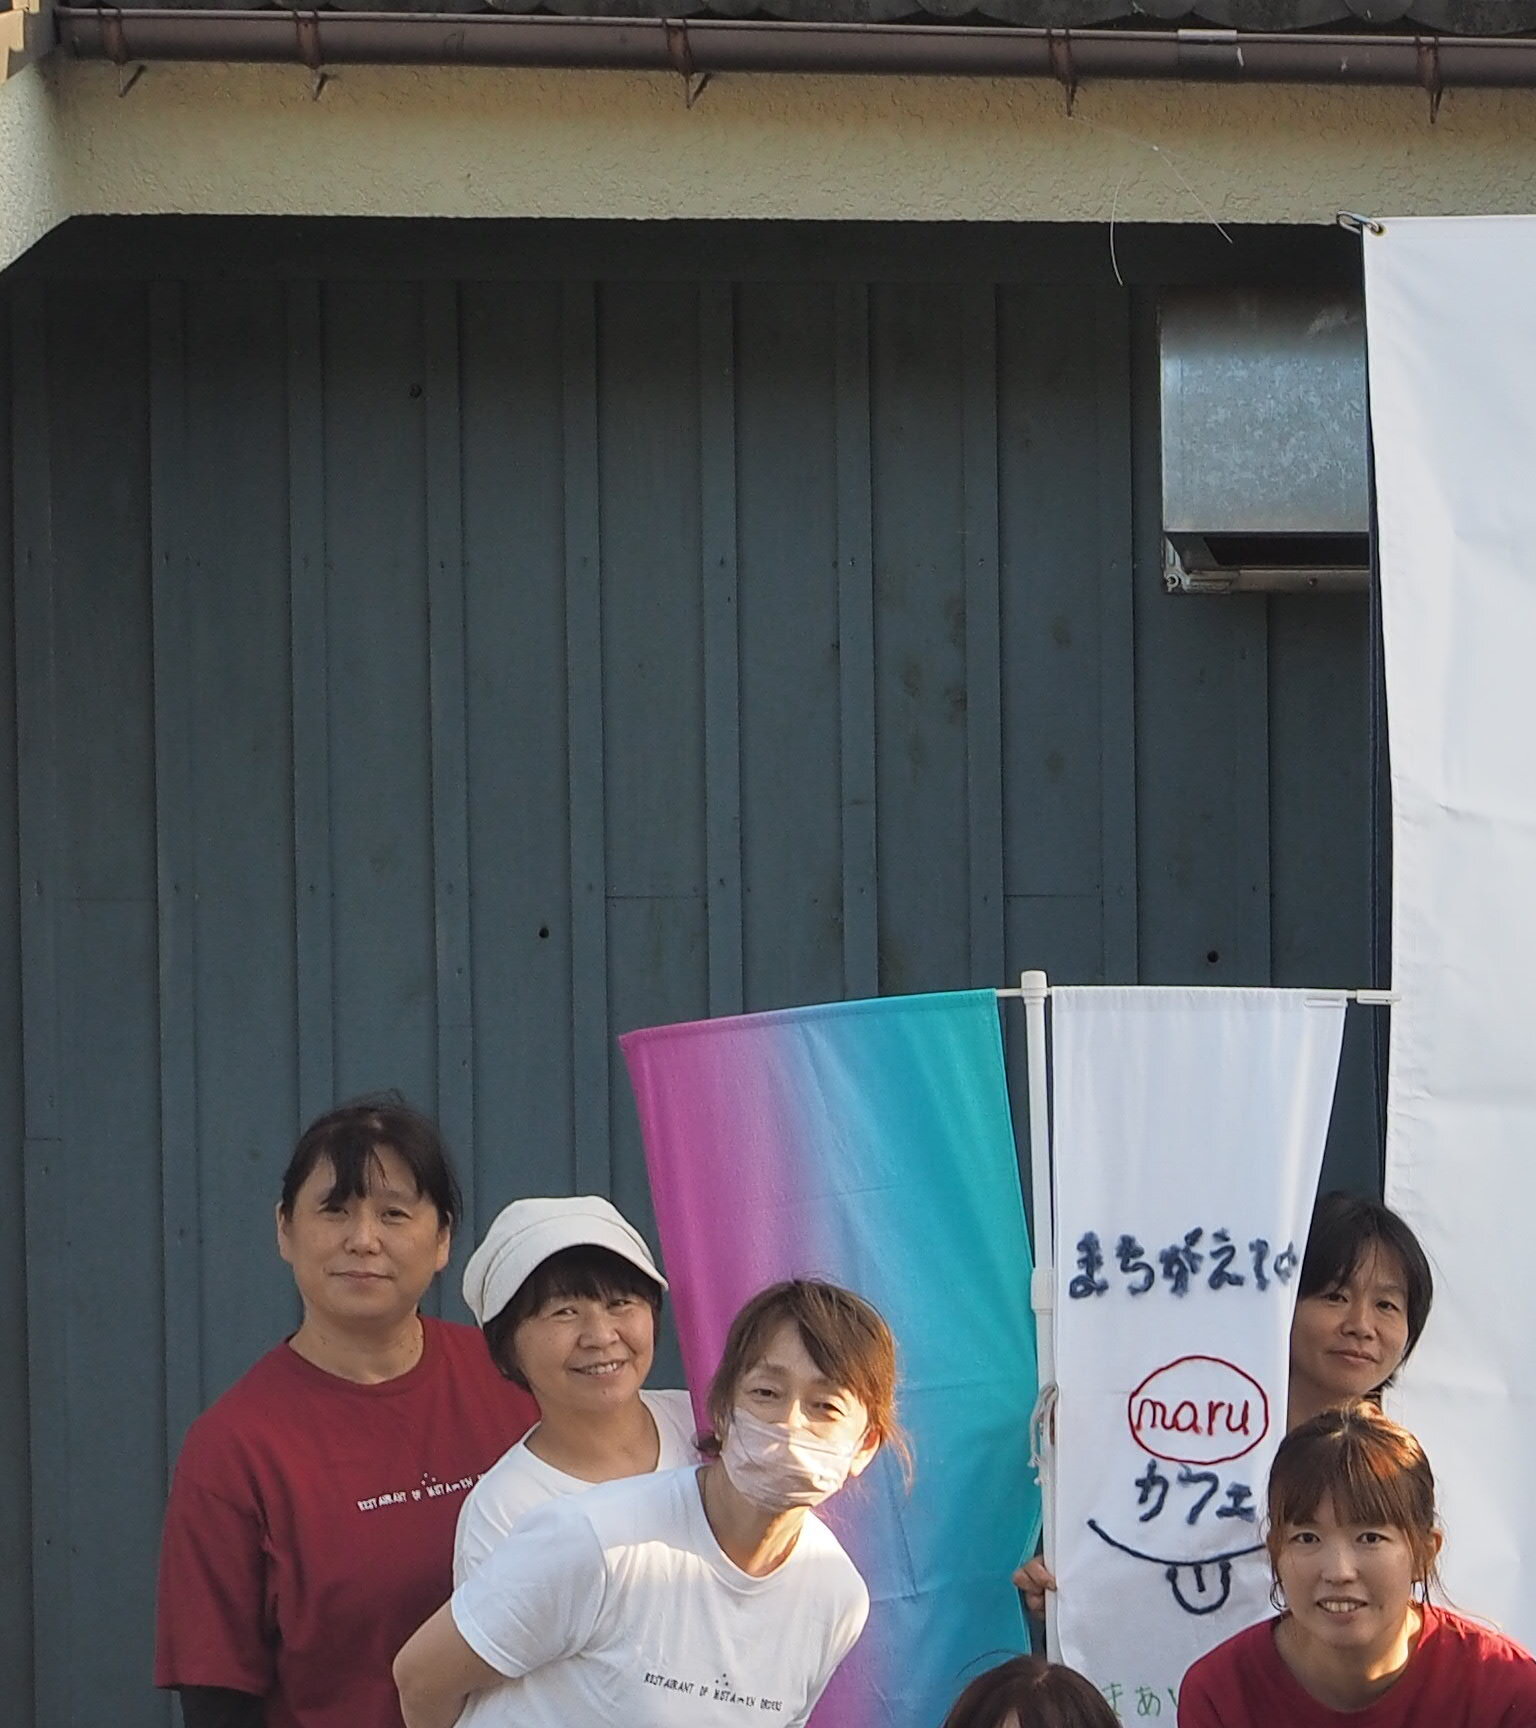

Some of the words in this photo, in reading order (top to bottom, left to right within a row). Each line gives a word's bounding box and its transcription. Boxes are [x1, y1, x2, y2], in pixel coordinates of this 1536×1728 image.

[1135, 1398, 1250, 1436] maru
[1135, 1459, 1257, 1525] カフェ
